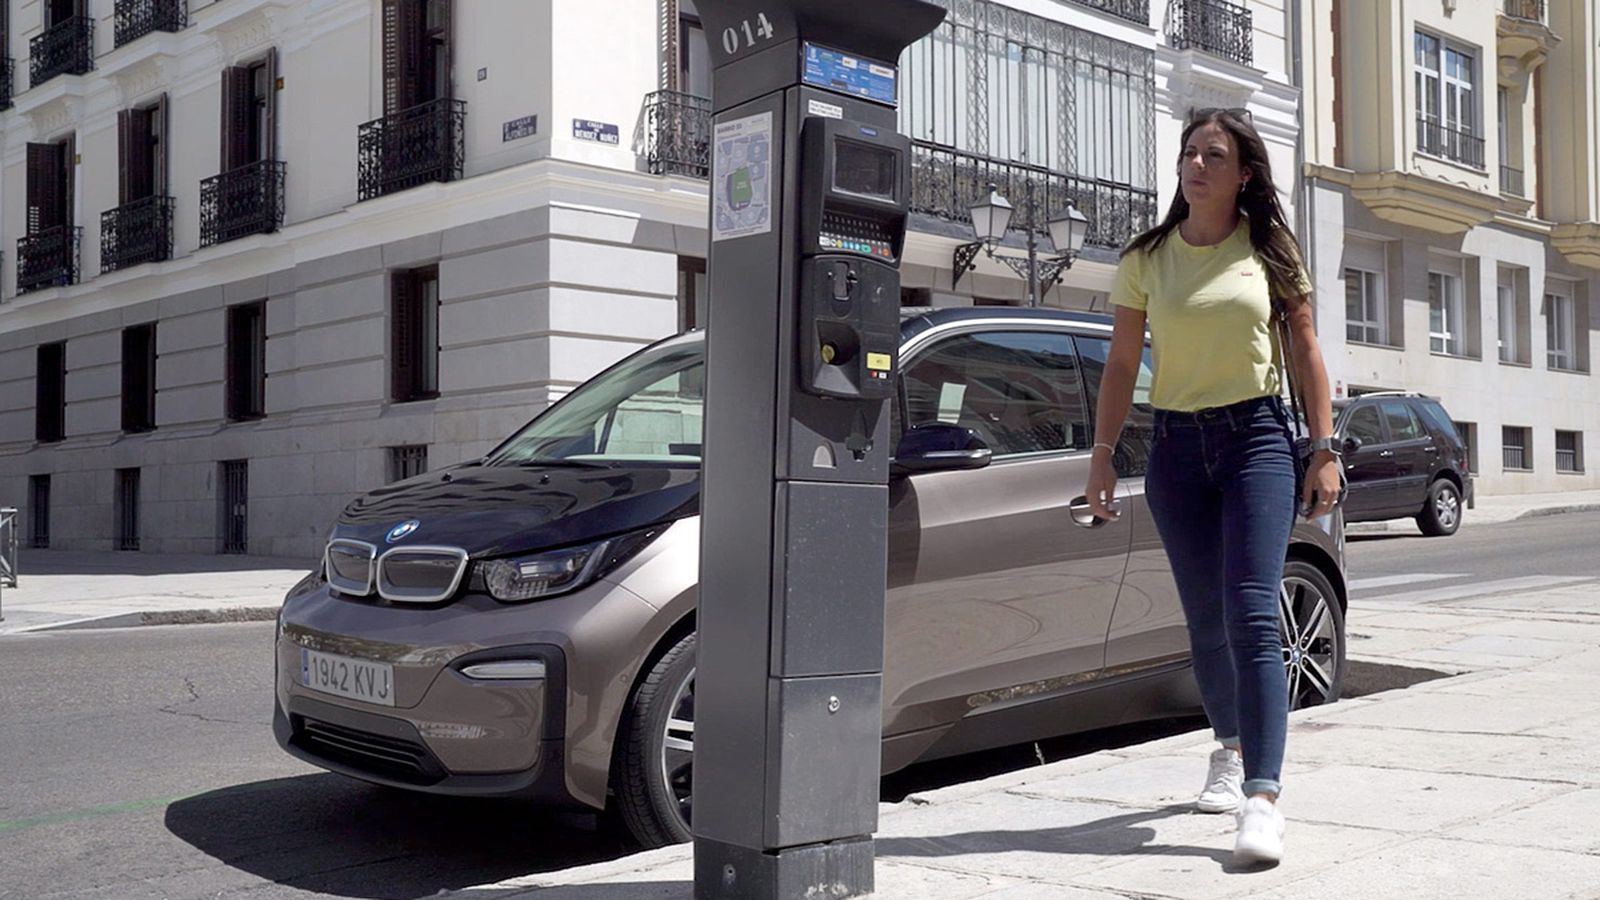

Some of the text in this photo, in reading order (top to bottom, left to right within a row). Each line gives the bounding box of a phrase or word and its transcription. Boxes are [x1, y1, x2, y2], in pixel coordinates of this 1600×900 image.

[722, 12, 774, 55] 014
[313, 657, 349, 691] 1942
[354, 665, 388, 699] KVJ
